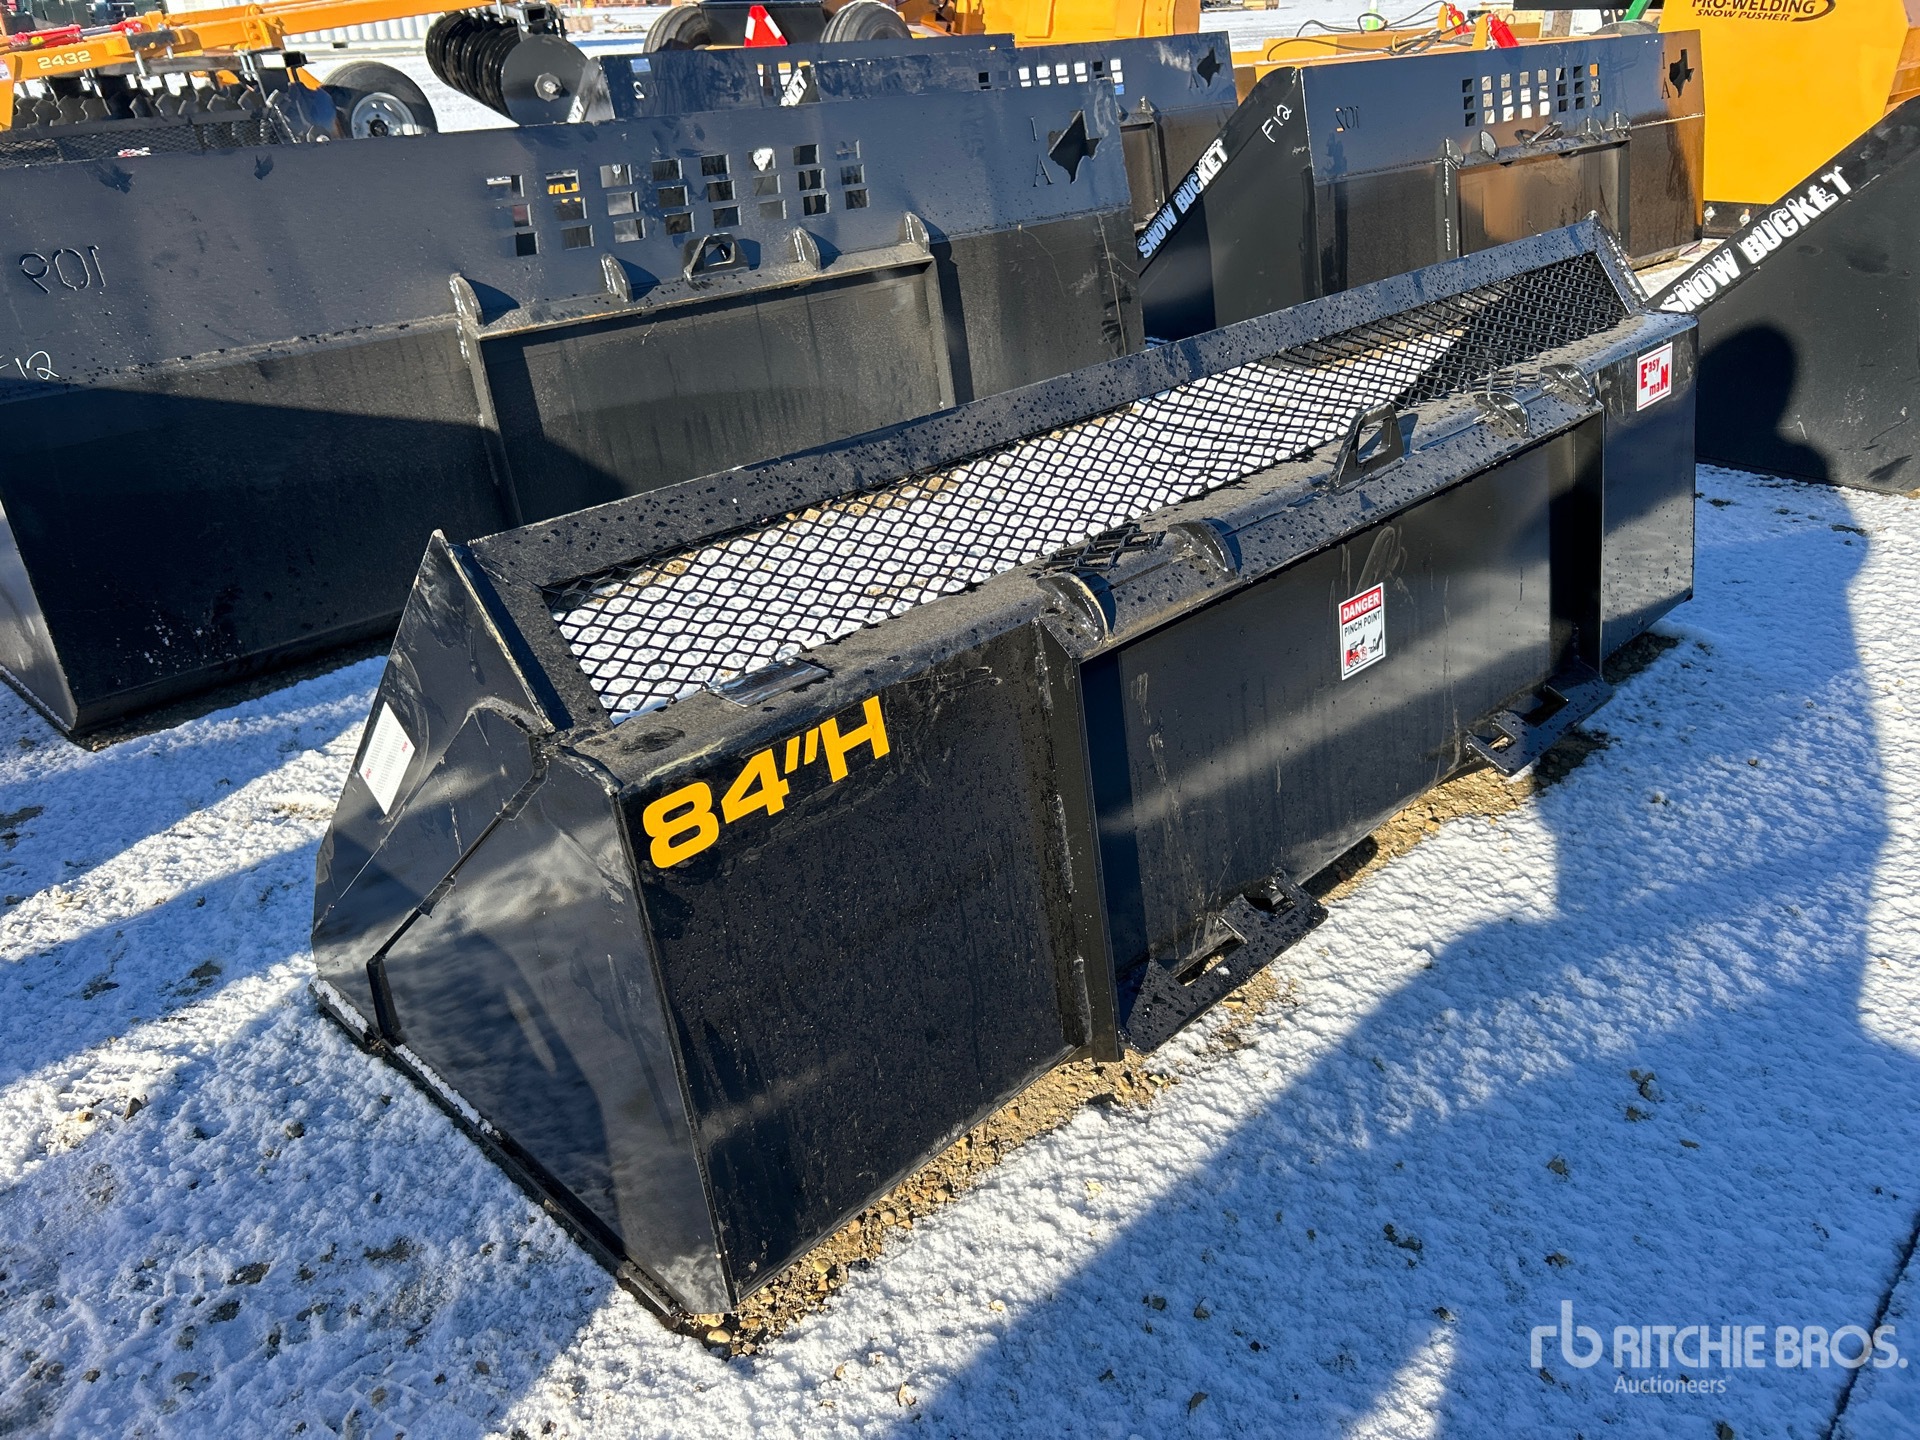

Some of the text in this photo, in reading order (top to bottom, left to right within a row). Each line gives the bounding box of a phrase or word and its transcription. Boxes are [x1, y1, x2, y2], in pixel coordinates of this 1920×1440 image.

[1695, 9, 1790, 21] SNOW PUSHER
[37, 50, 92, 69] 2432
[1261, 104, 1292, 143] F12
[1137, 139, 1228, 258] SNOW BUCKET
[1737, 166, 1852, 264] BUCKET
[1342, 591, 1381, 621] DANGER
[1344, 611, 1381, 637] PINCH POINT
